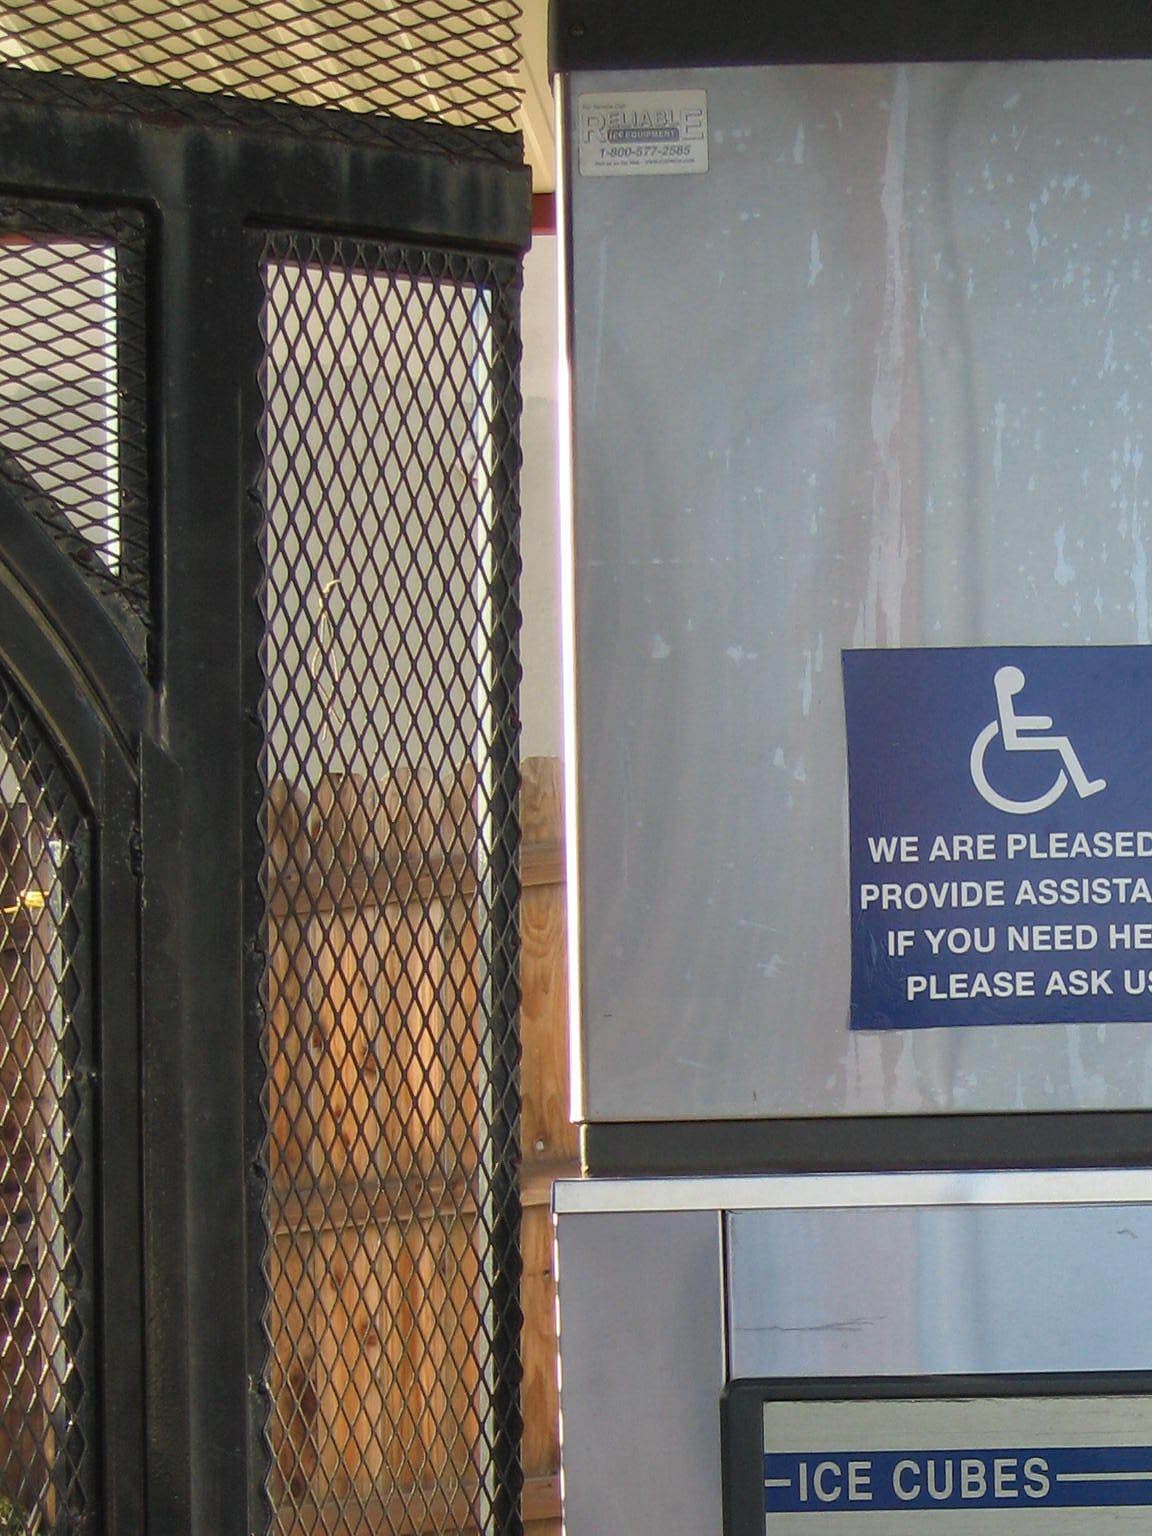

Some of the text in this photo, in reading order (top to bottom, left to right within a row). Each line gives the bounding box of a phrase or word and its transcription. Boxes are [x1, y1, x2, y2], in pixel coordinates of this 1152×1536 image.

[867, 835, 920, 863] WE
[928, 834, 997, 861] ARE
[859, 880, 1005, 910] PROVIDE
[887, 929, 914, 956] IF
[923, 927, 996, 954] YOU
[1007, 925, 1099, 952] NEED
[906, 971, 1035, 1001] PLEASE
[1044, 970, 1112, 996] ASK
[799, 1457, 1050, 1502] ICE CUBES
